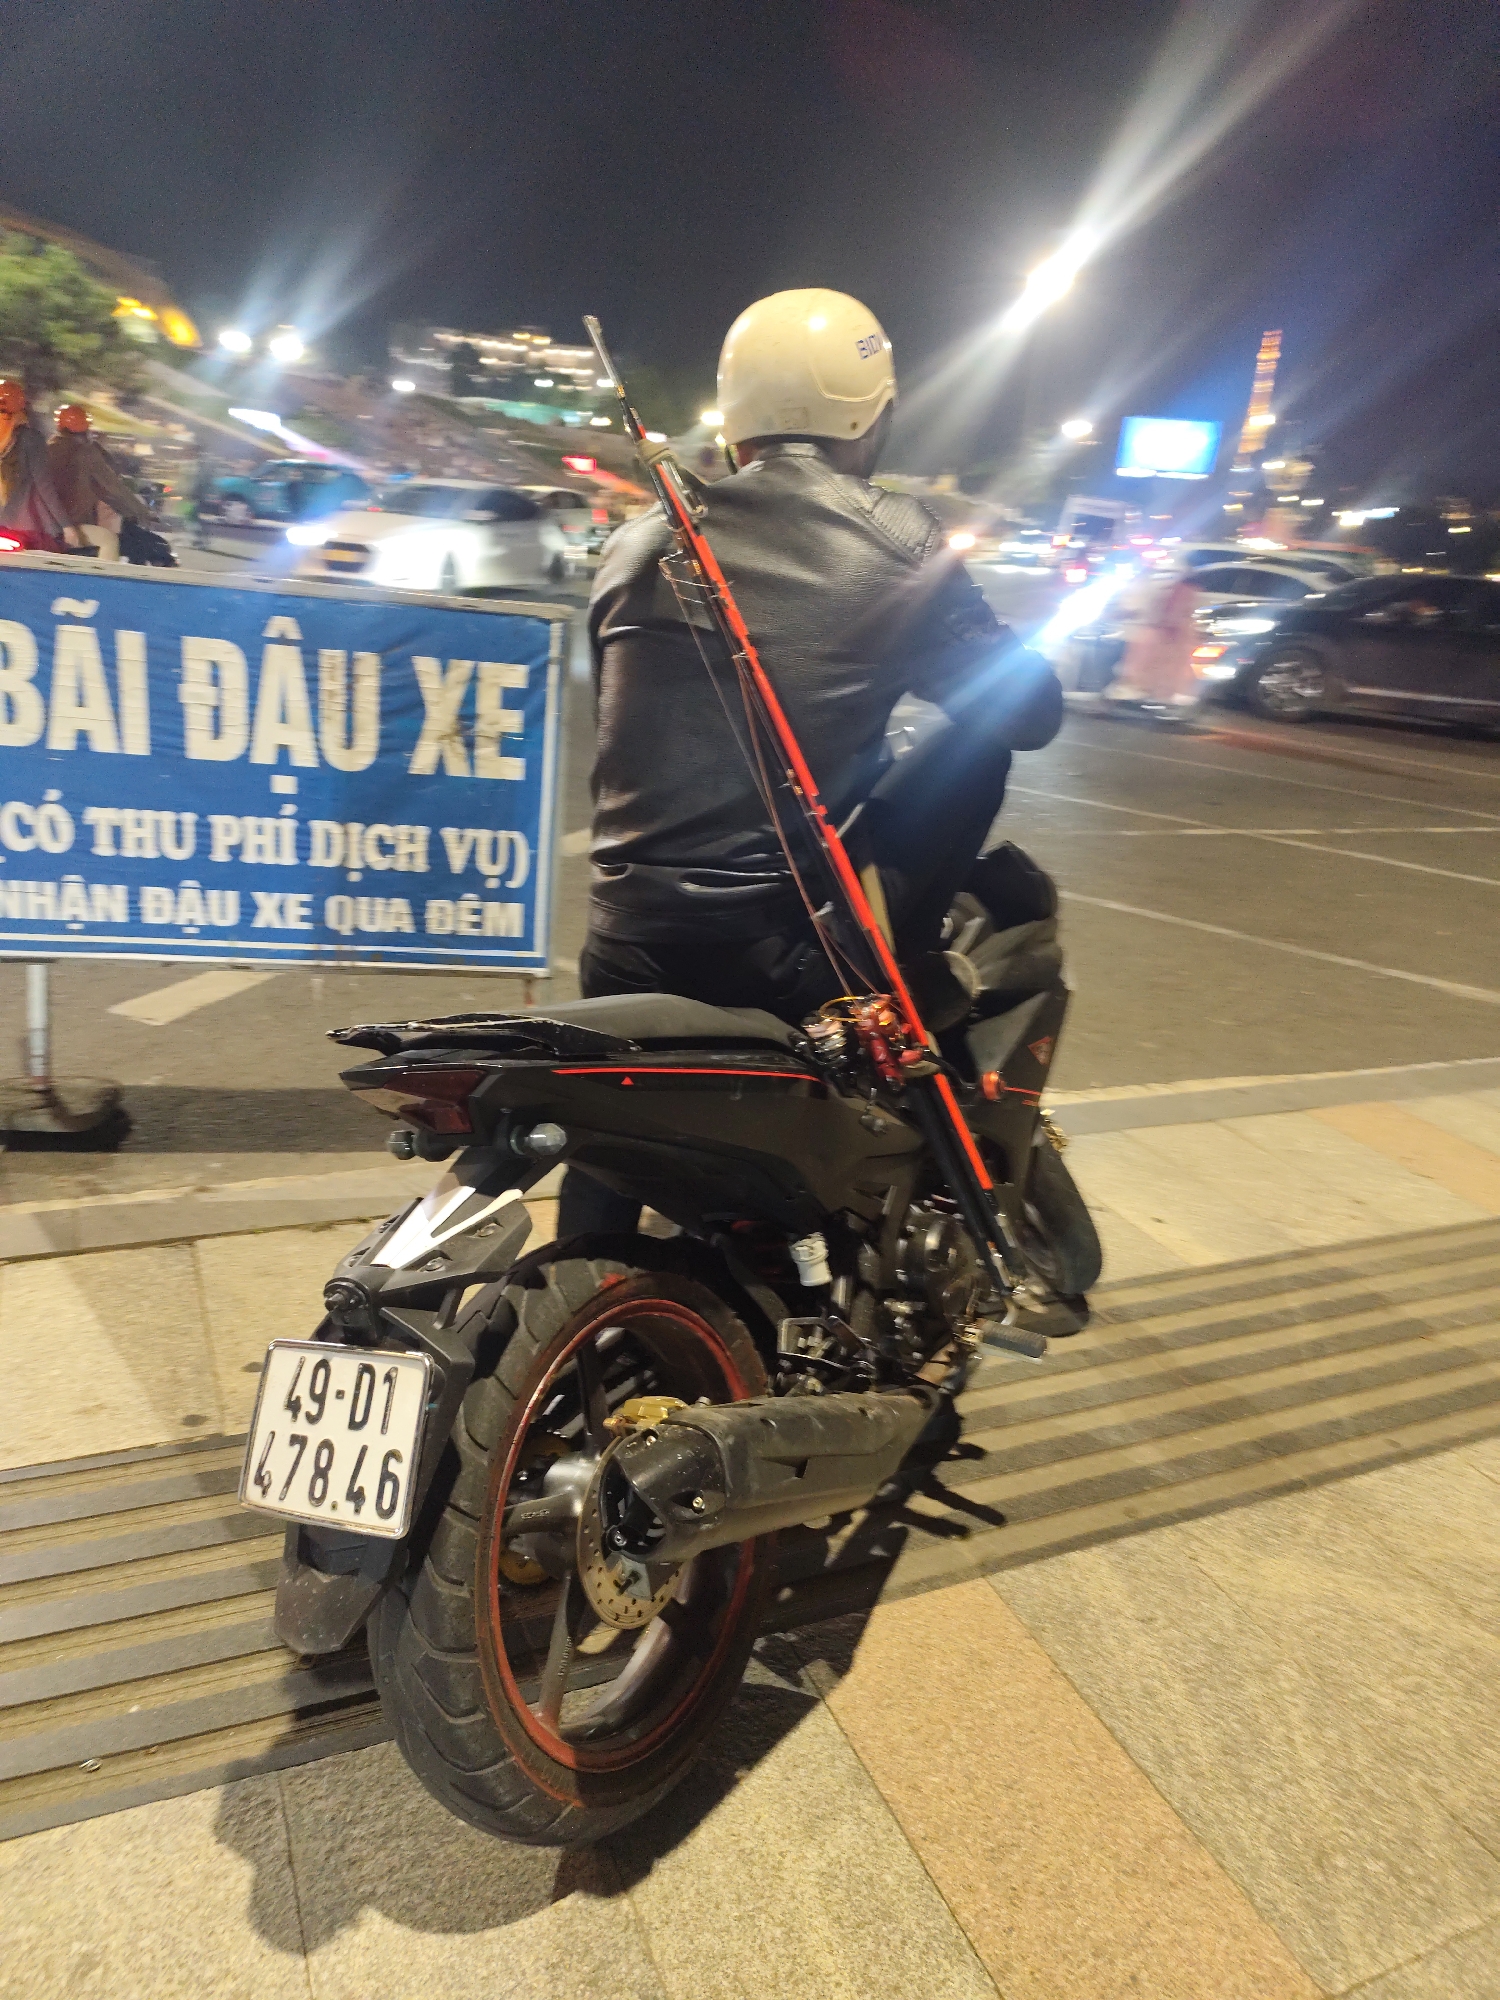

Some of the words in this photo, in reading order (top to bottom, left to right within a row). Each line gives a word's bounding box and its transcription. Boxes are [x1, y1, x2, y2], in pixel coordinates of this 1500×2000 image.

[0, 597, 151, 756] BÃI
[179, 616, 382, 794] ĐẬU
[408, 655, 530, 781] XE
[0, 789, 75, 864] CÓ
[82, 806, 199, 860] THU
[207, 803, 300, 866] PHÍ
[307, 820, 432, 882] DỊCH
[439, 826, 530, 889] VỤ)
[0, 874, 129, 930] NHẬN
[139, 879, 241, 934] ĐẬU
[250, 891, 314, 930] XE
[324, 895, 416, 936] QUA
[425, 893, 525, 938] ĐÊM
[283, 1356, 398, 1435] 49-D1
[254, 1431, 403, 1520] 478.46
